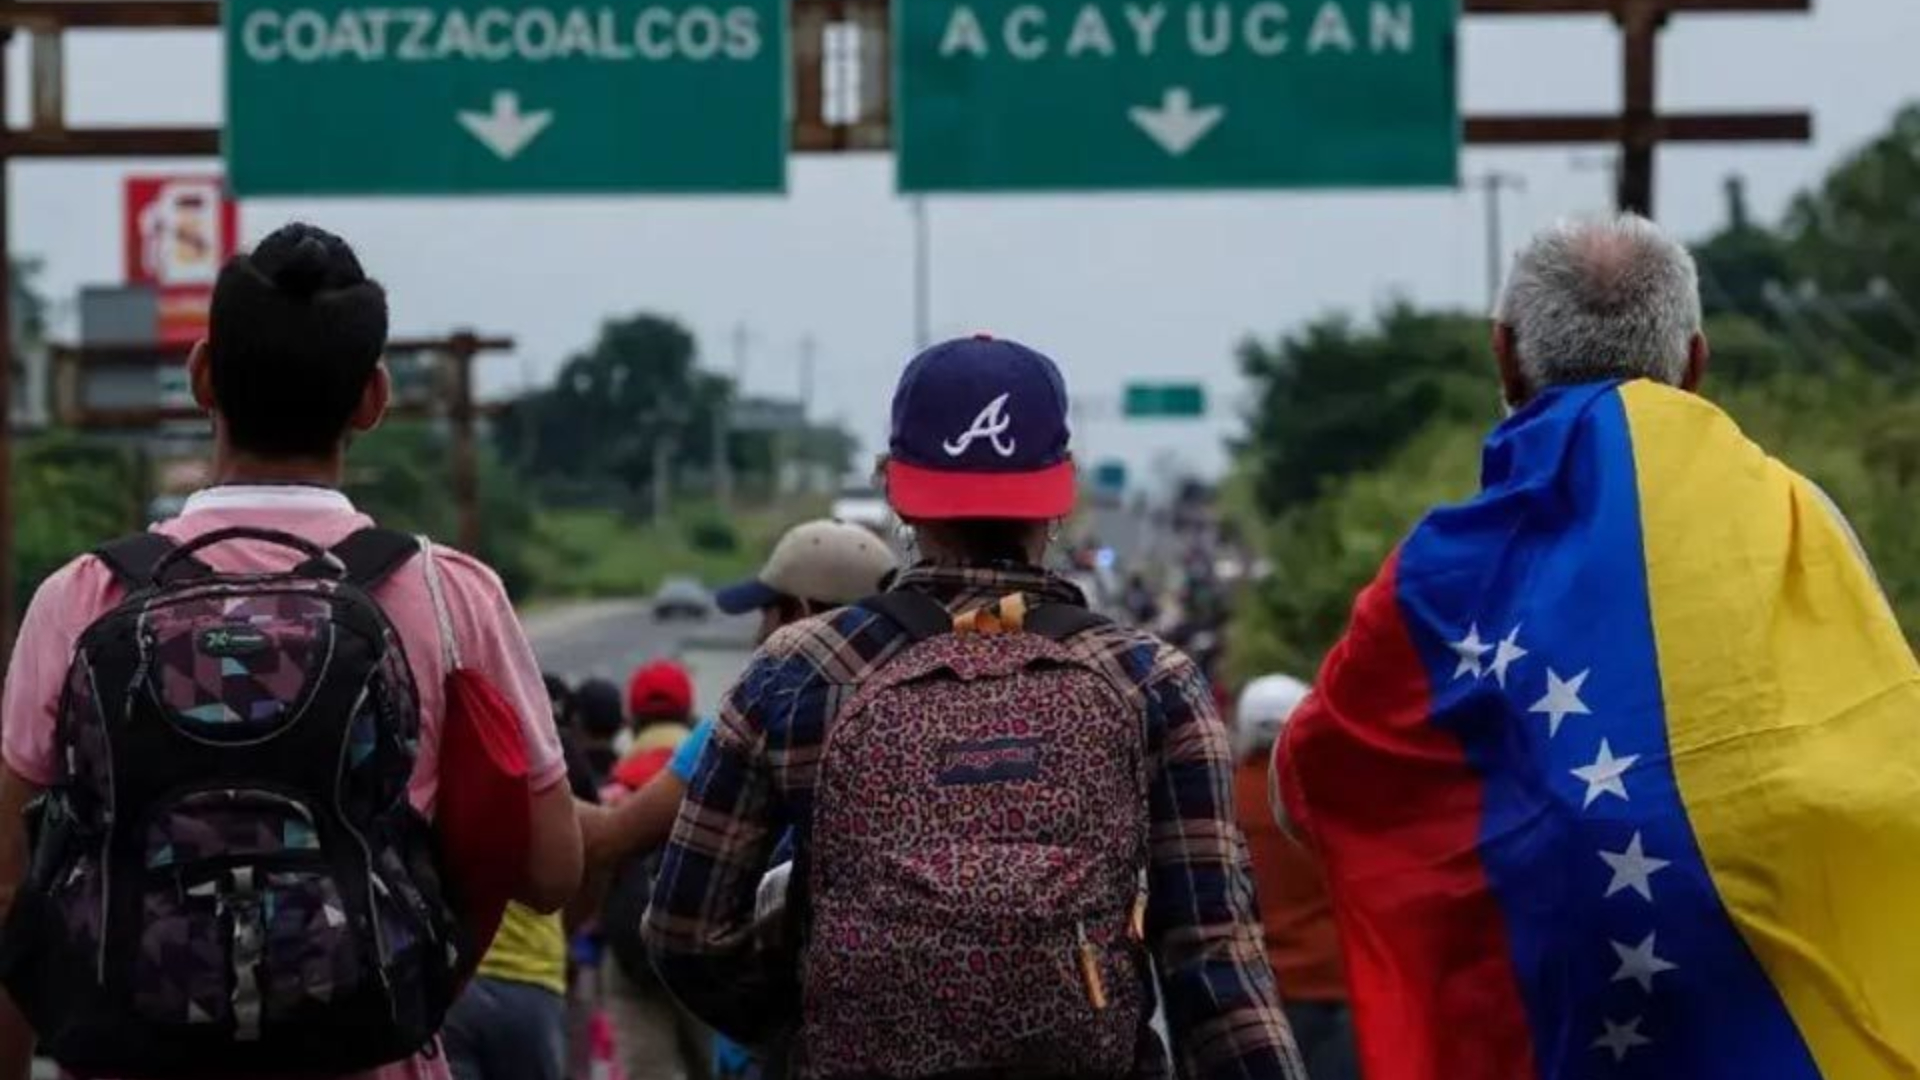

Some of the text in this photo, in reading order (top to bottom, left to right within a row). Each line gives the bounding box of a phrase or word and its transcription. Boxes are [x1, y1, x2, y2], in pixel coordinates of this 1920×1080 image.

[243, 9, 761, 61] COATZACOALCOS
[939, 1, 1413, 59] ACAYUCAN
[943, 392, 1015, 457] A
